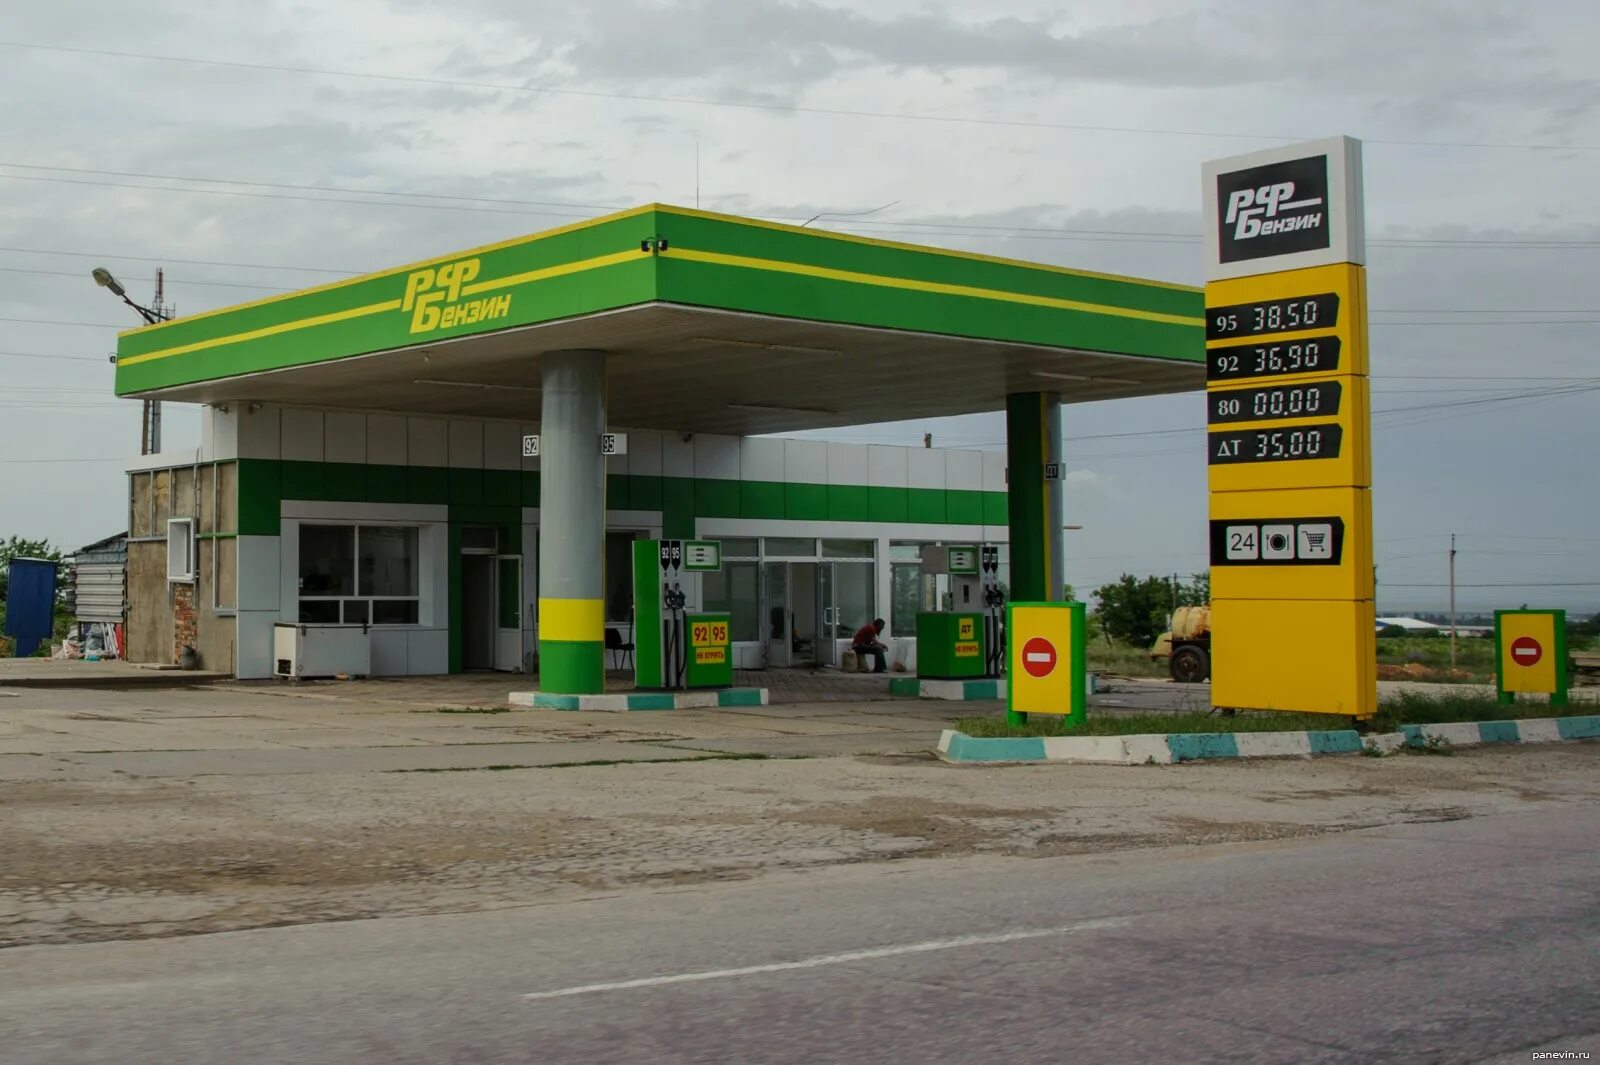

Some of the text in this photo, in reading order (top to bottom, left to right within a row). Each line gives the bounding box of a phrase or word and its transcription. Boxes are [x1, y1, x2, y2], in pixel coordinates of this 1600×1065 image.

[1226, 182, 1294, 224] РФ
[1234, 207, 1322, 241] Бензин
[402, 258, 480, 312] РФ
[409, 290, 512, 334] Бензин
[1216, 301, 1317, 332] 95 38.50
[1217, 343, 1318, 373] 92 36.90
[1218, 388, 1320, 416] 80 00.00
[525, 439, 537, 454] 92
[603, 437, 615, 452] 95
[1256, 430, 1321, 458] 35.00
[1231, 533, 1254, 551] 24
[661, 547, 670, 559] 92
[671, 547, 680, 559] 95
[694, 627, 708, 641] 92
[713, 626, 726, 640] 95
[961, 624, 971, 633] ДТ
[696, 651, 724, 660] НЕ КУРИТЬ
